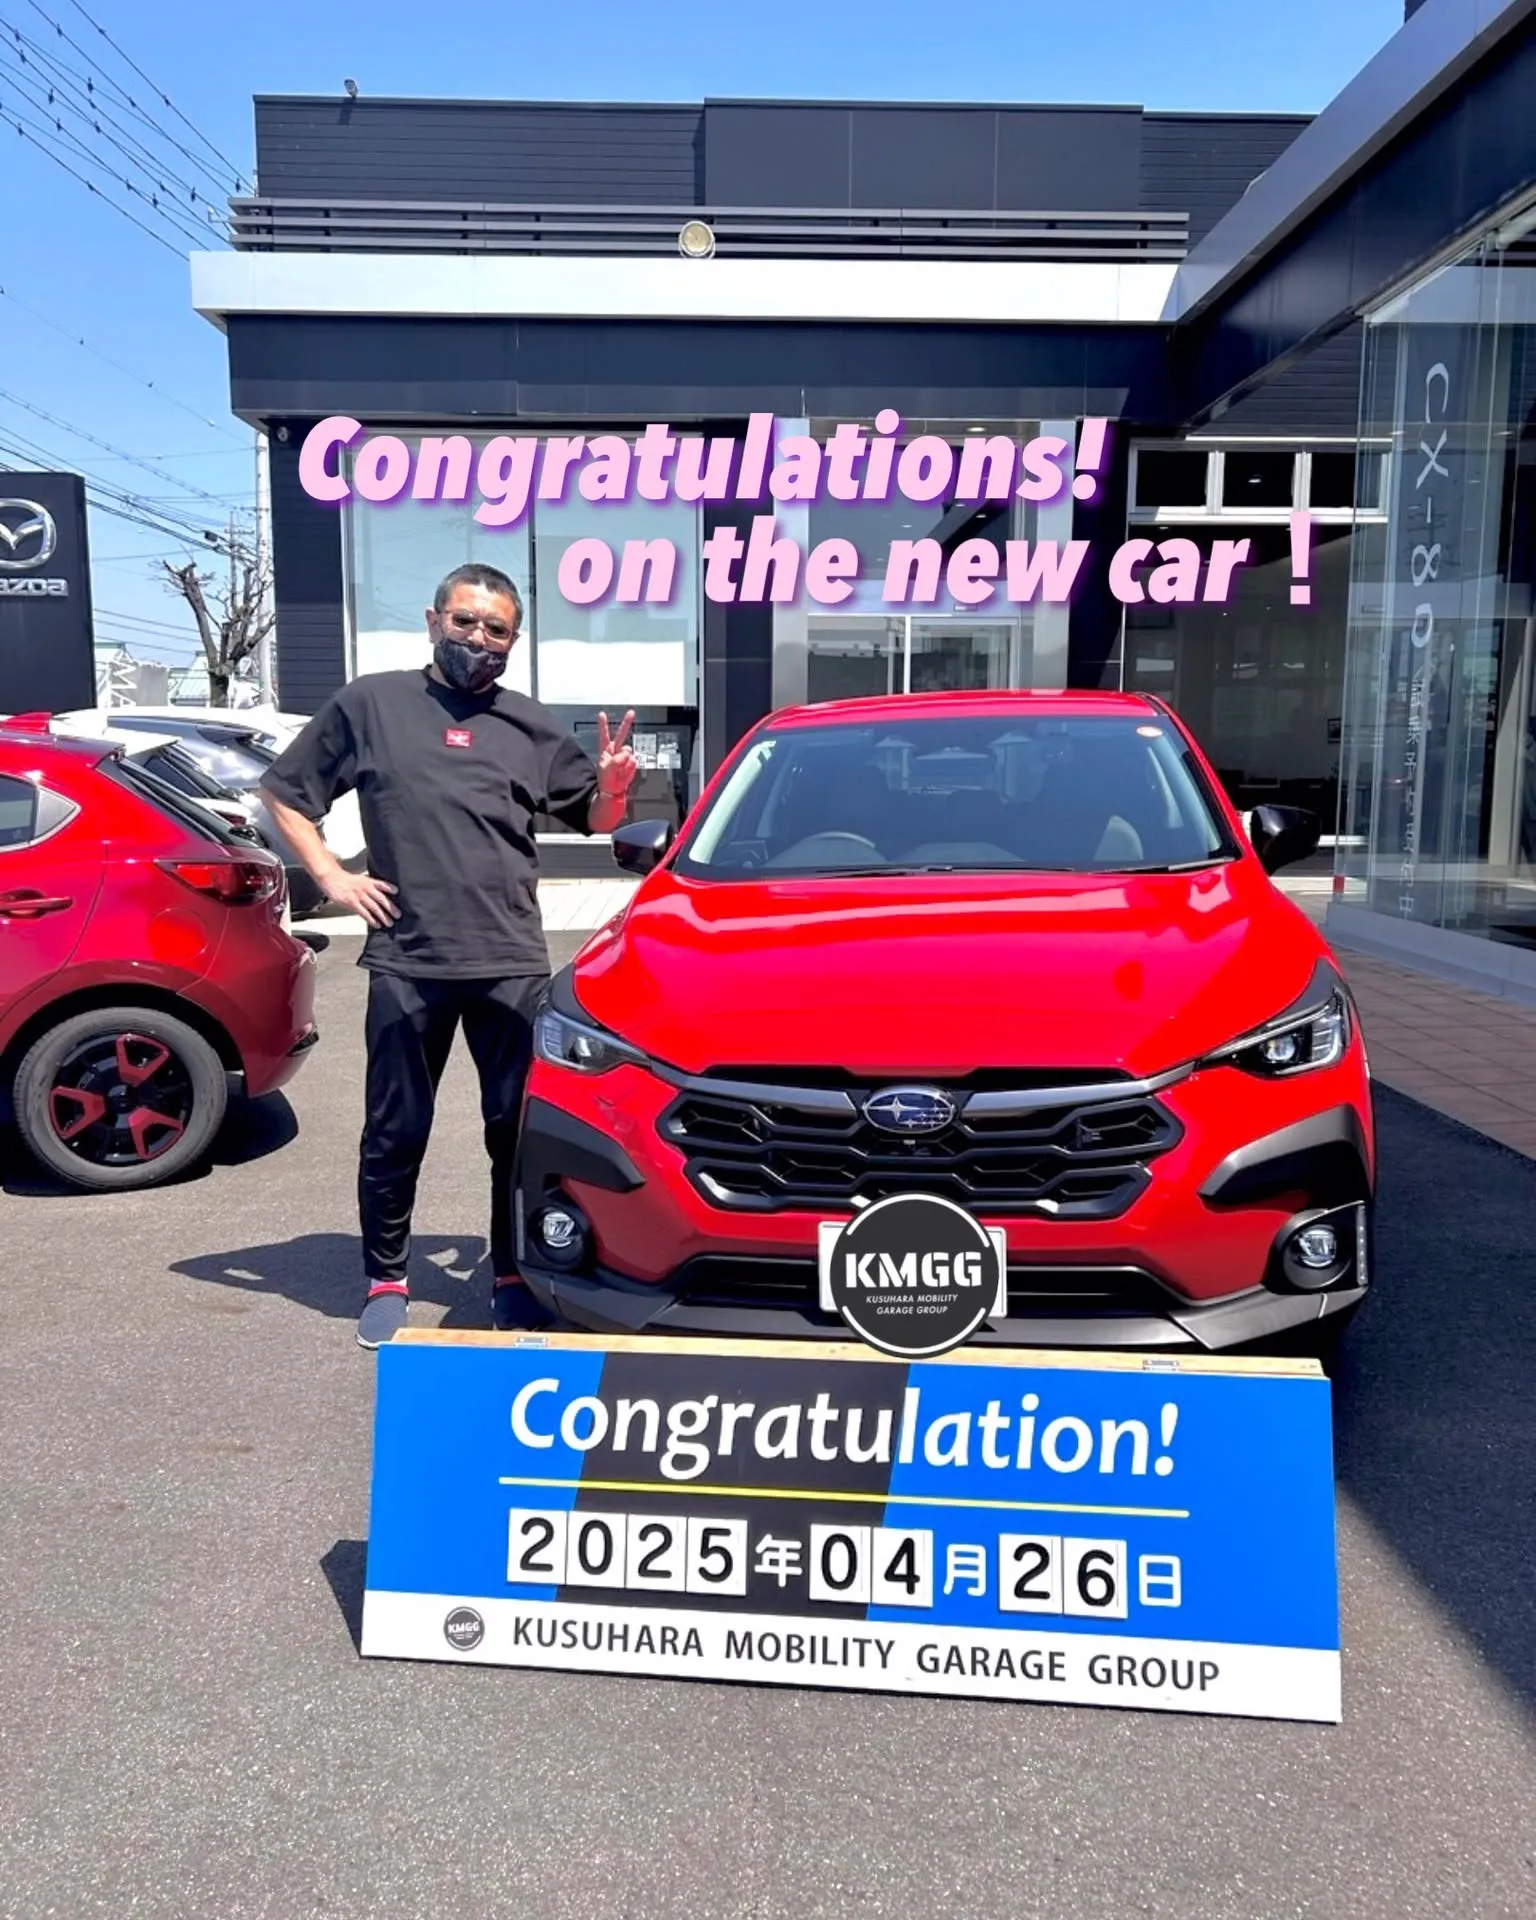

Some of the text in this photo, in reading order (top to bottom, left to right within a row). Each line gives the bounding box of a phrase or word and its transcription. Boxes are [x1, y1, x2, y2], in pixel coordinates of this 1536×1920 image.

[511, 1378, 1179, 1480] Congratulation!
[519, 1516, 1183, 1609] 2025年04月26日
[514, 1617, 1220, 1692] KUSUHARA MOBILITY GARAGE GROUP
